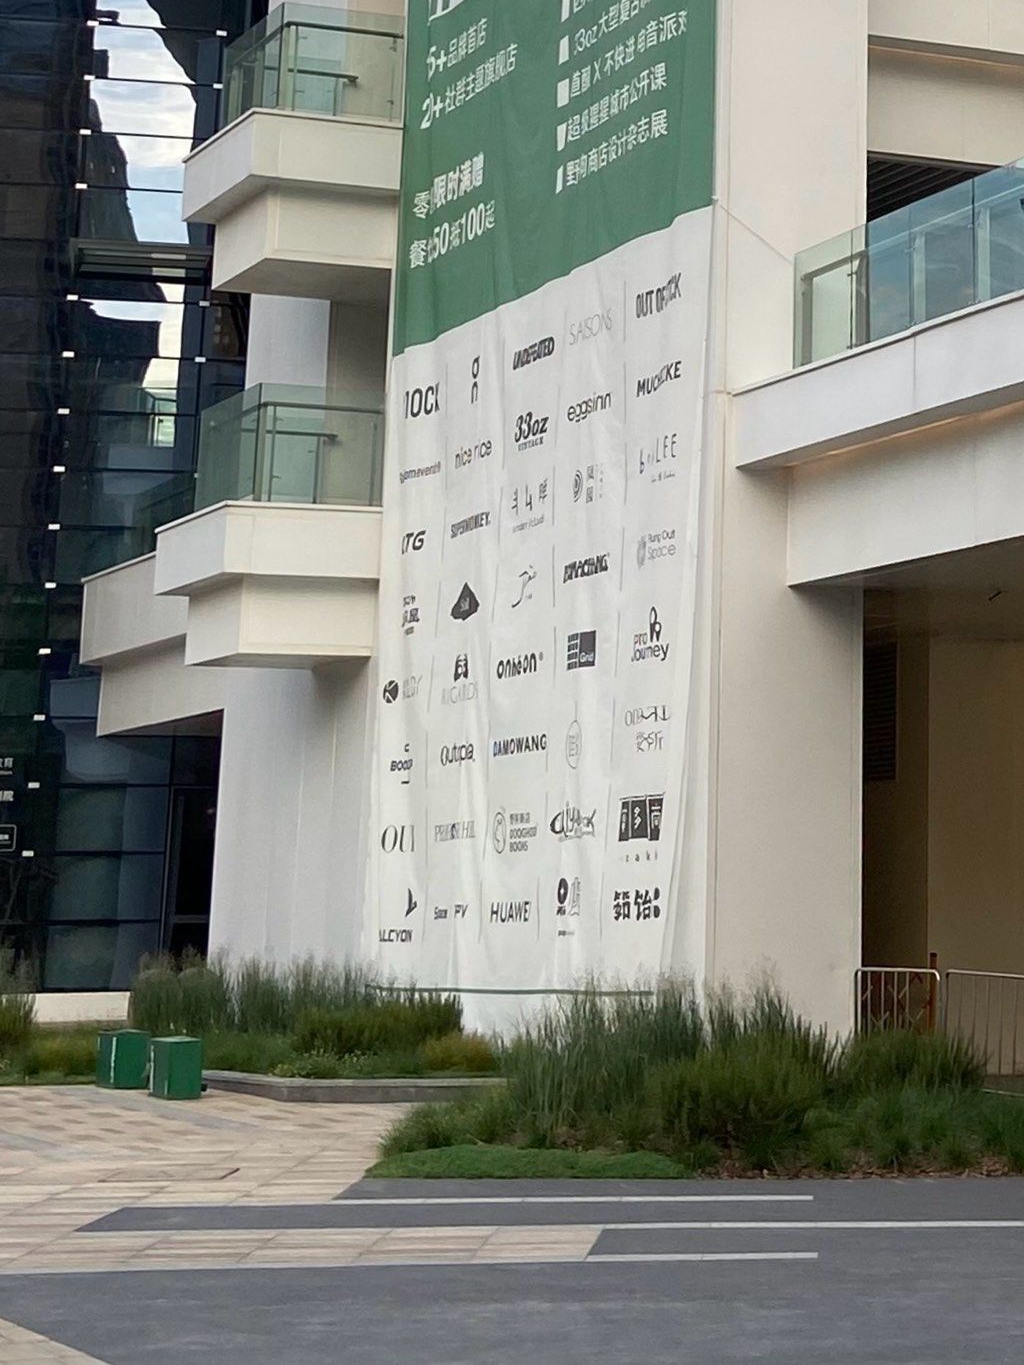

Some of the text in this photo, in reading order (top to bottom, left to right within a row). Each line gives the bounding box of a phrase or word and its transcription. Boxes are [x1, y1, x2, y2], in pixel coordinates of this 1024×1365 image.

[412, 151, 485, 219] 零限时满赠
[635, 288, 655, 319] OUT
[569, 307, 614, 346] SAISONS
[567, 391, 612, 423] eggsinn
[514, 411, 549, 444] 33oz
[493, 733, 547, 758] DAMOWANG
